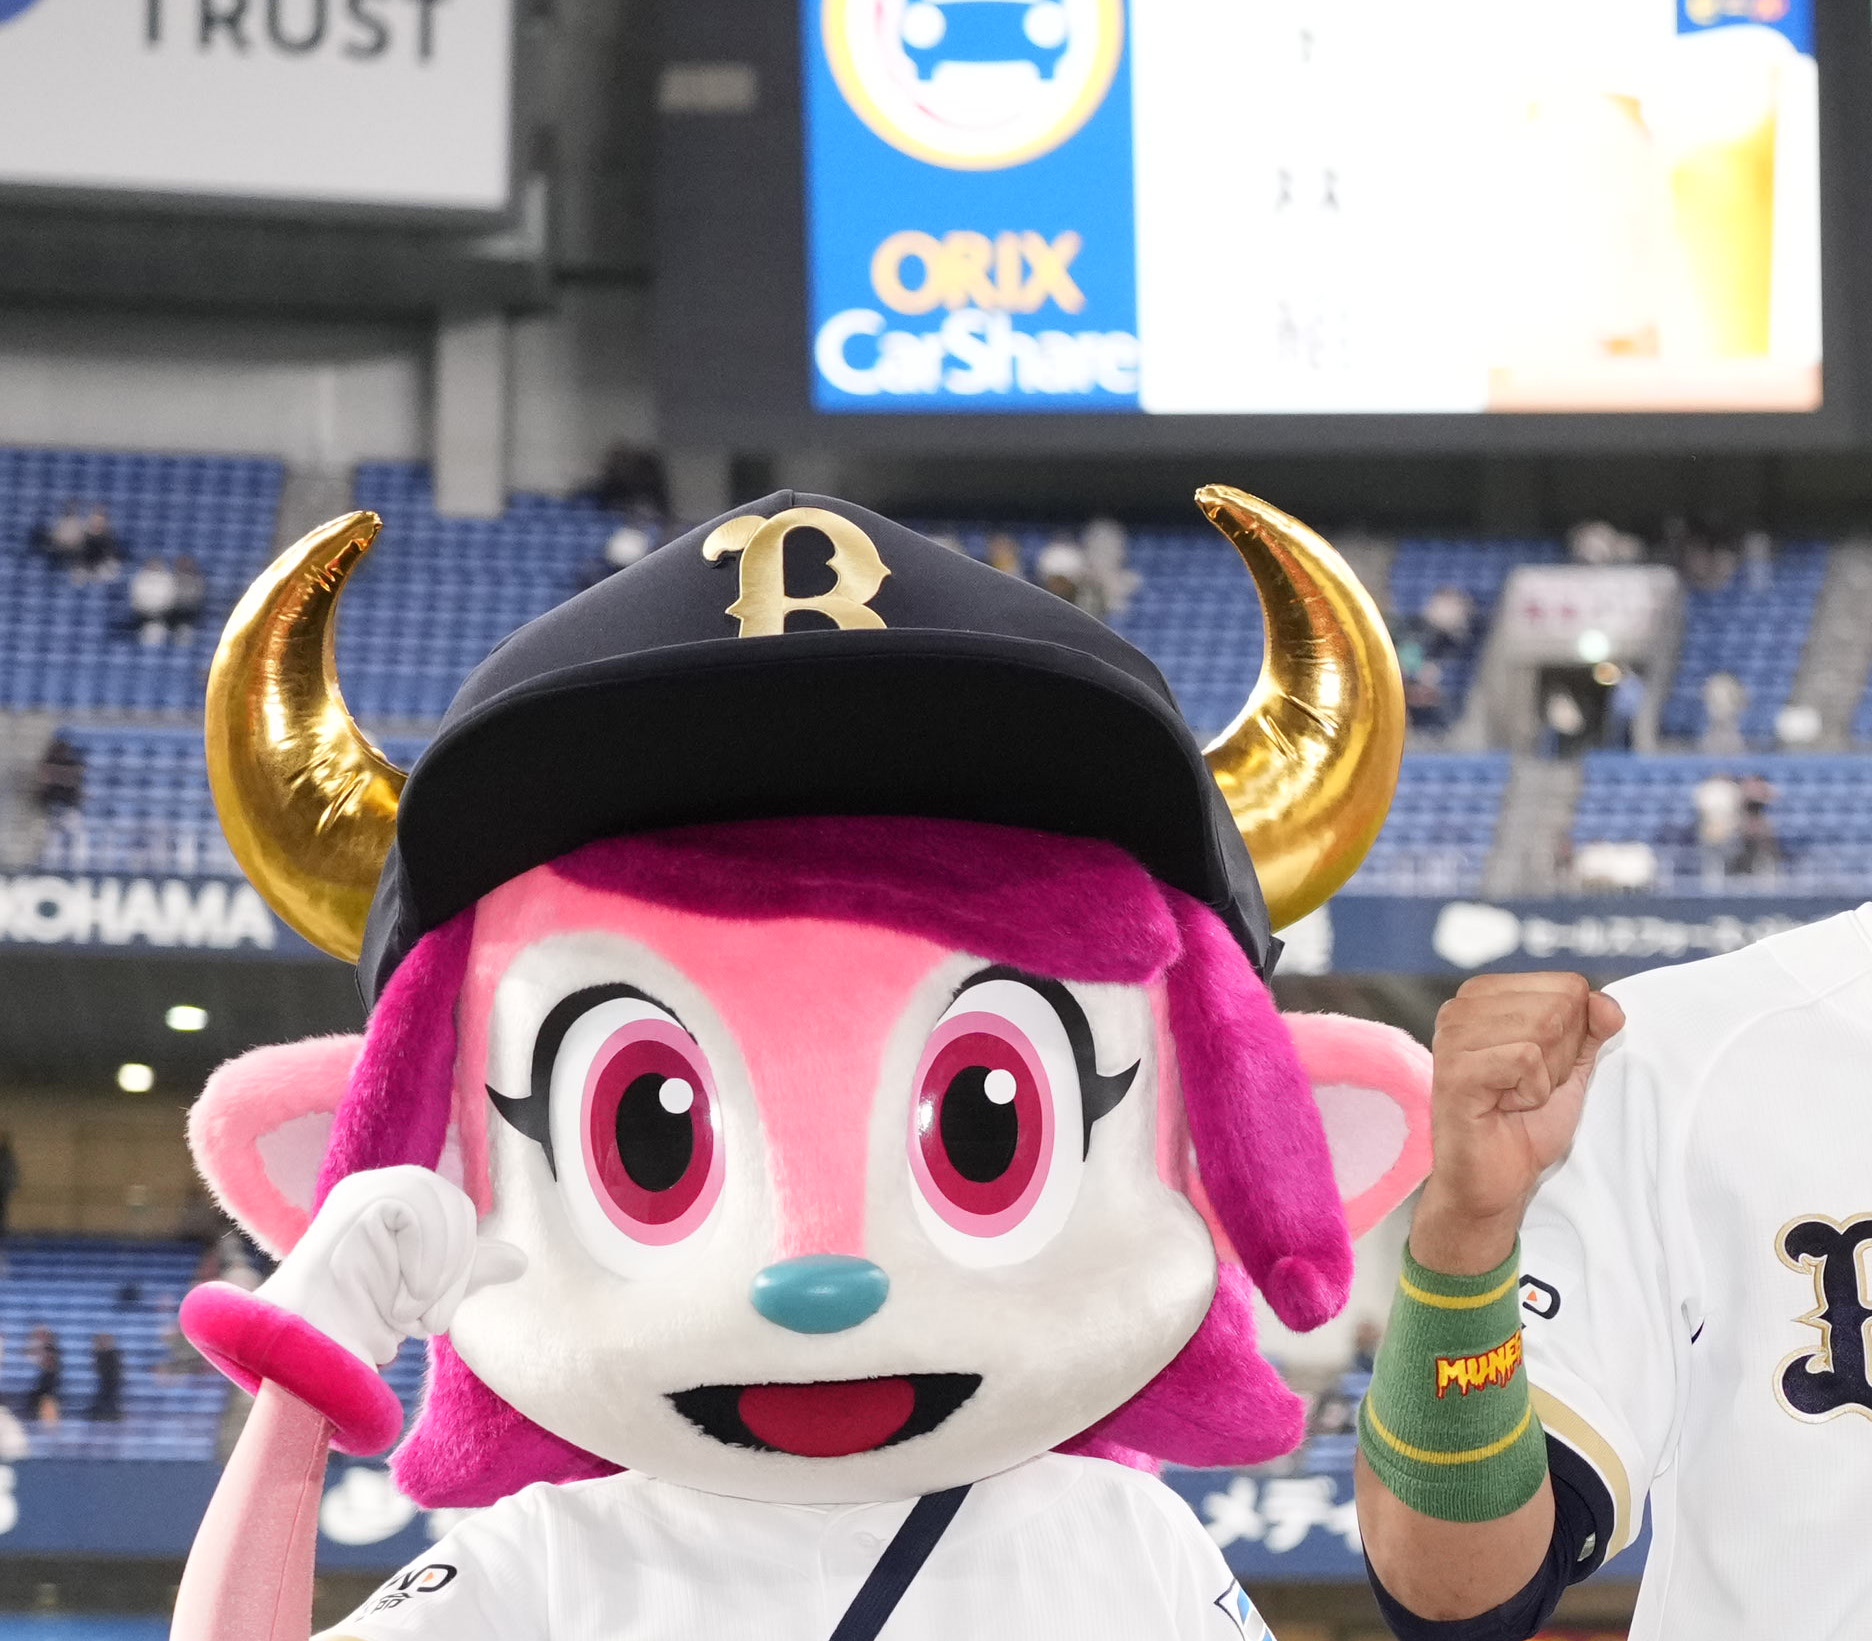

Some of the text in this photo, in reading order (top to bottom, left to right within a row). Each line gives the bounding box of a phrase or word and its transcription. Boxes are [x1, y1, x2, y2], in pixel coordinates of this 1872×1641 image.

[870, 229, 1087, 314] ORIX
[813, 307, 1142, 395] CarShare
[702, 506, 892, 638] B
